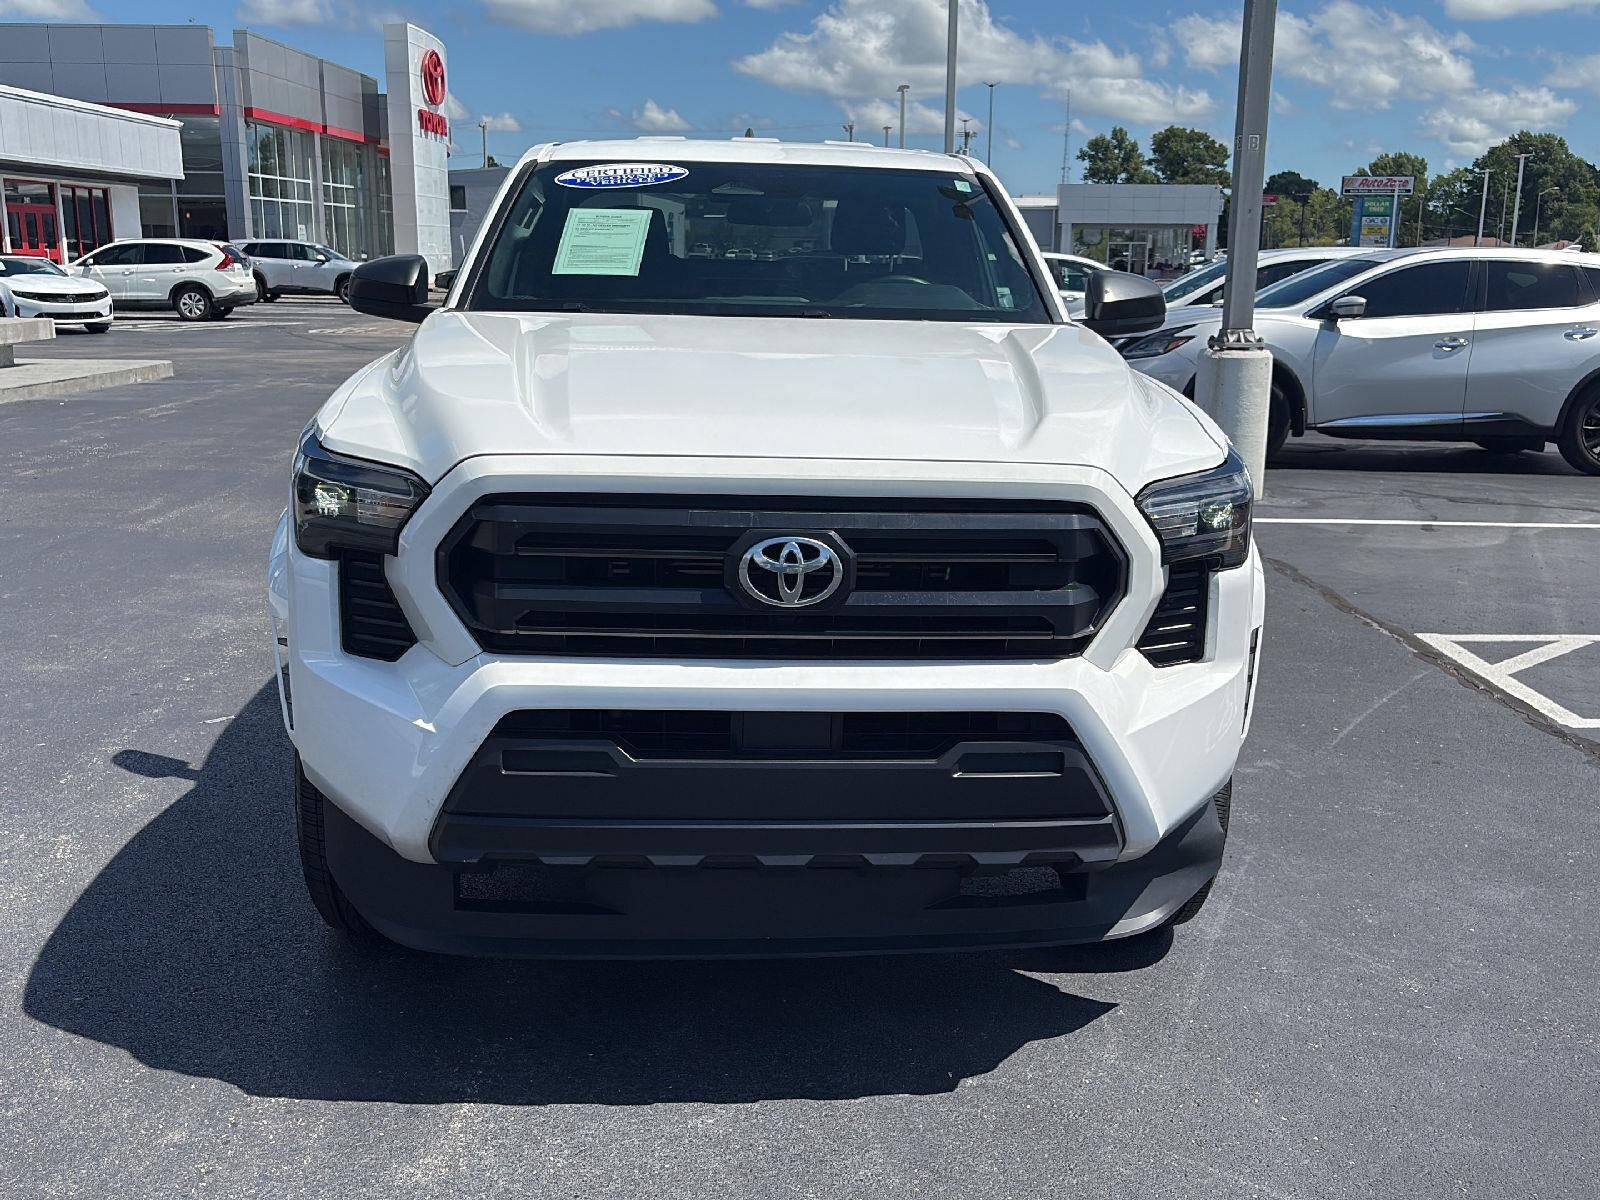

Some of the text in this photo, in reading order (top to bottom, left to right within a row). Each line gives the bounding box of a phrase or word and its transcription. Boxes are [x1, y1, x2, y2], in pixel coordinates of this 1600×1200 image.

[418, 108, 448, 137] TOYOT
[571, 167, 673, 179] CERTIFIED
[590, 177, 656, 186] VEHICLE
